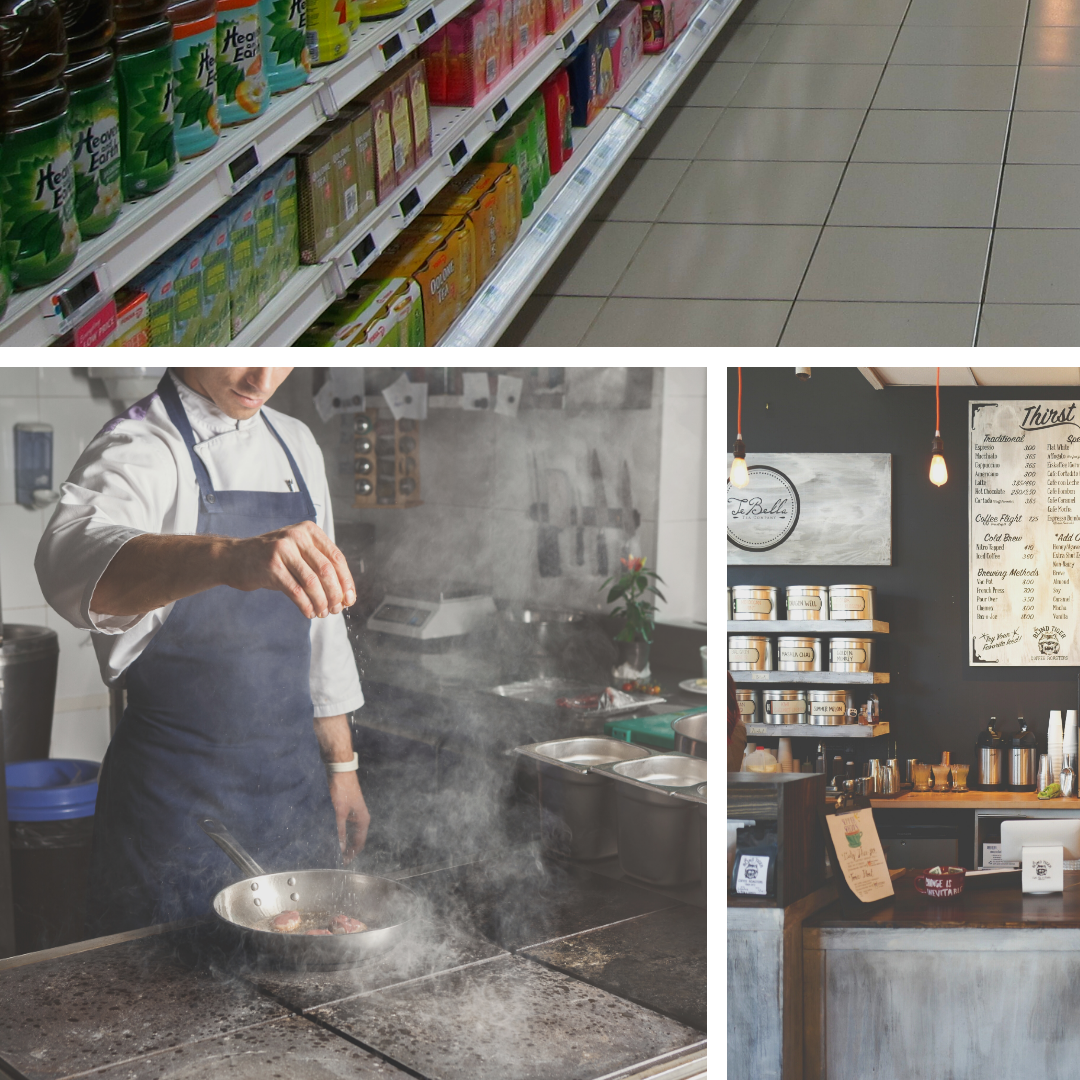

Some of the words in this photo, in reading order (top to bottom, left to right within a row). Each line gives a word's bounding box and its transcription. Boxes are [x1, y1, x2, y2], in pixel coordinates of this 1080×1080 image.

[1021, 402, 1077, 427] Thirst
[983, 434, 1026, 443] Traditional
[974, 443, 995, 452] Espresso
[974, 513, 999, 526] Coffee
[999, 513, 1023, 526] Flight
[983, 533, 1002, 542] Cold
[1003, 533, 1022, 542] Brew
[977, 568, 1007, 580] Brewing
[1008, 568, 1039, 577] Methods
[1051, 625, 1067, 639] TIGER
